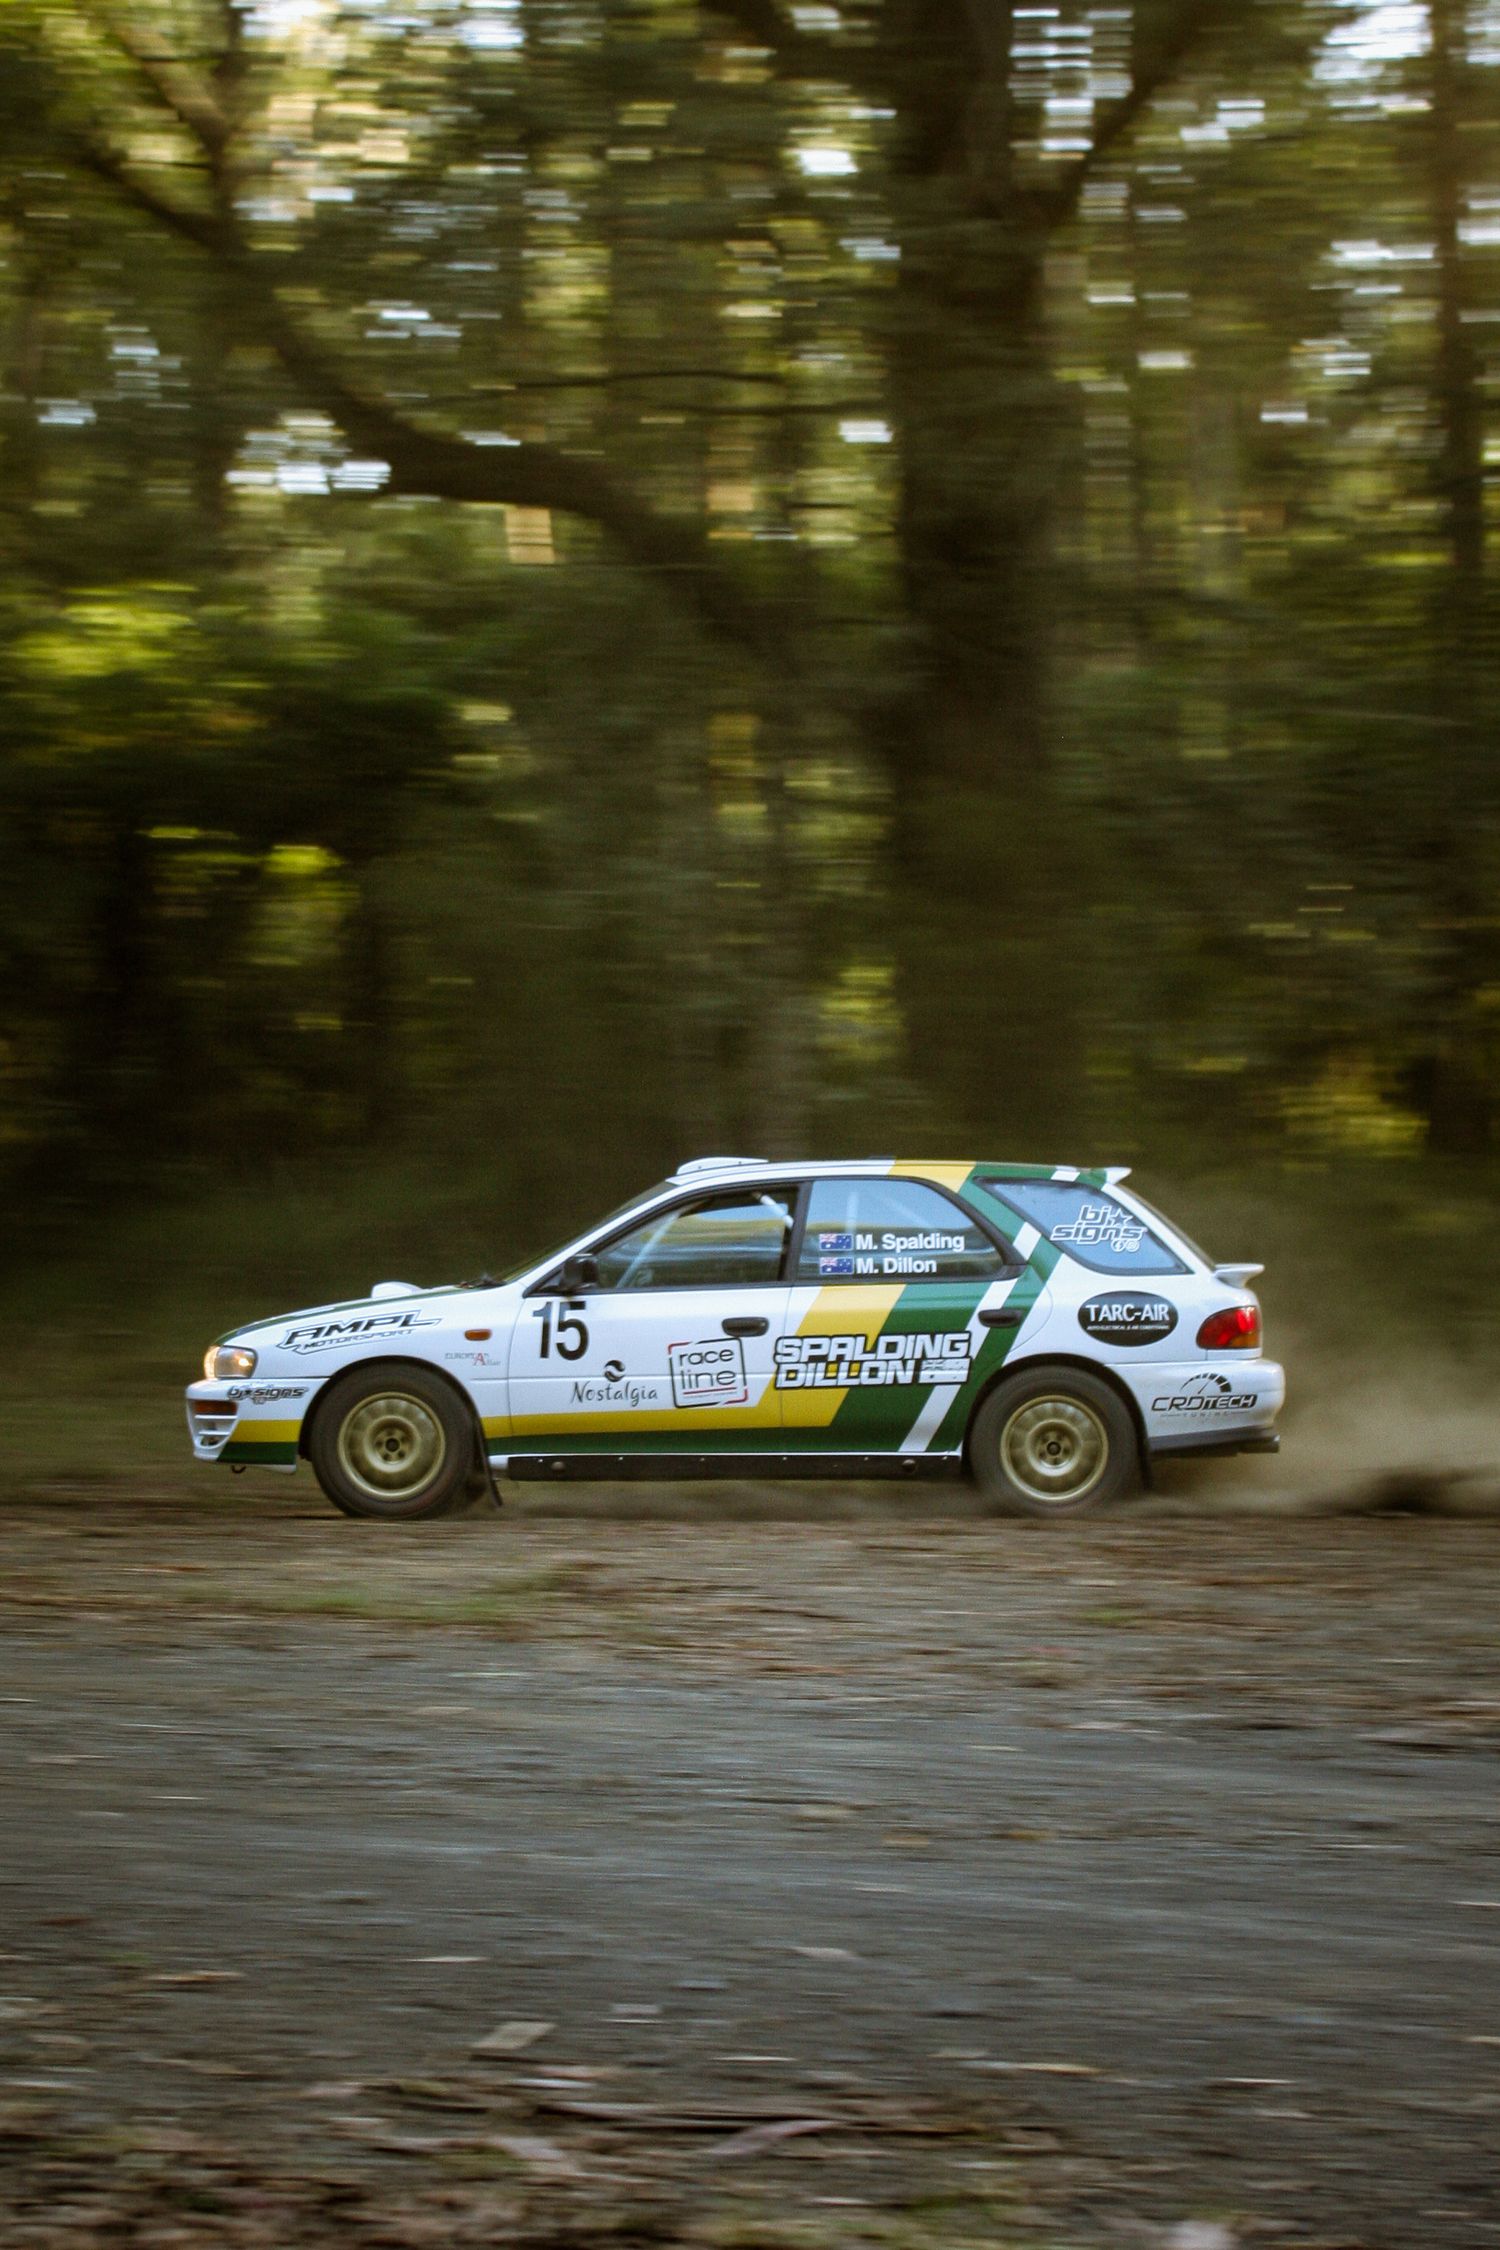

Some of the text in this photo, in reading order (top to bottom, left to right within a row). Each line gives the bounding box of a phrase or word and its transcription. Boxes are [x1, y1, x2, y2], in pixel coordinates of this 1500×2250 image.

[856, 1233, 965, 1252] M. Spalding
[1050, 1221, 1148, 1245] signs
[857, 1257, 937, 1274] M. Dillon
[1085, 1303, 1170, 1322] TARC-AIR
[286, 1313, 435, 1346] AMPL
[304, 1328, 417, 1350] MOTORSPORT
[532, 1301, 590, 1360] 15
[679, 1346, 735, 1366] race
[776, 1332, 970, 1363] SPALDING
[681, 1369, 737, 1390] line
[775, 1358, 916, 1388] DILLON
[255, 1386, 308, 1400] signs
[571, 1381, 658, 1407] Nostalgia
